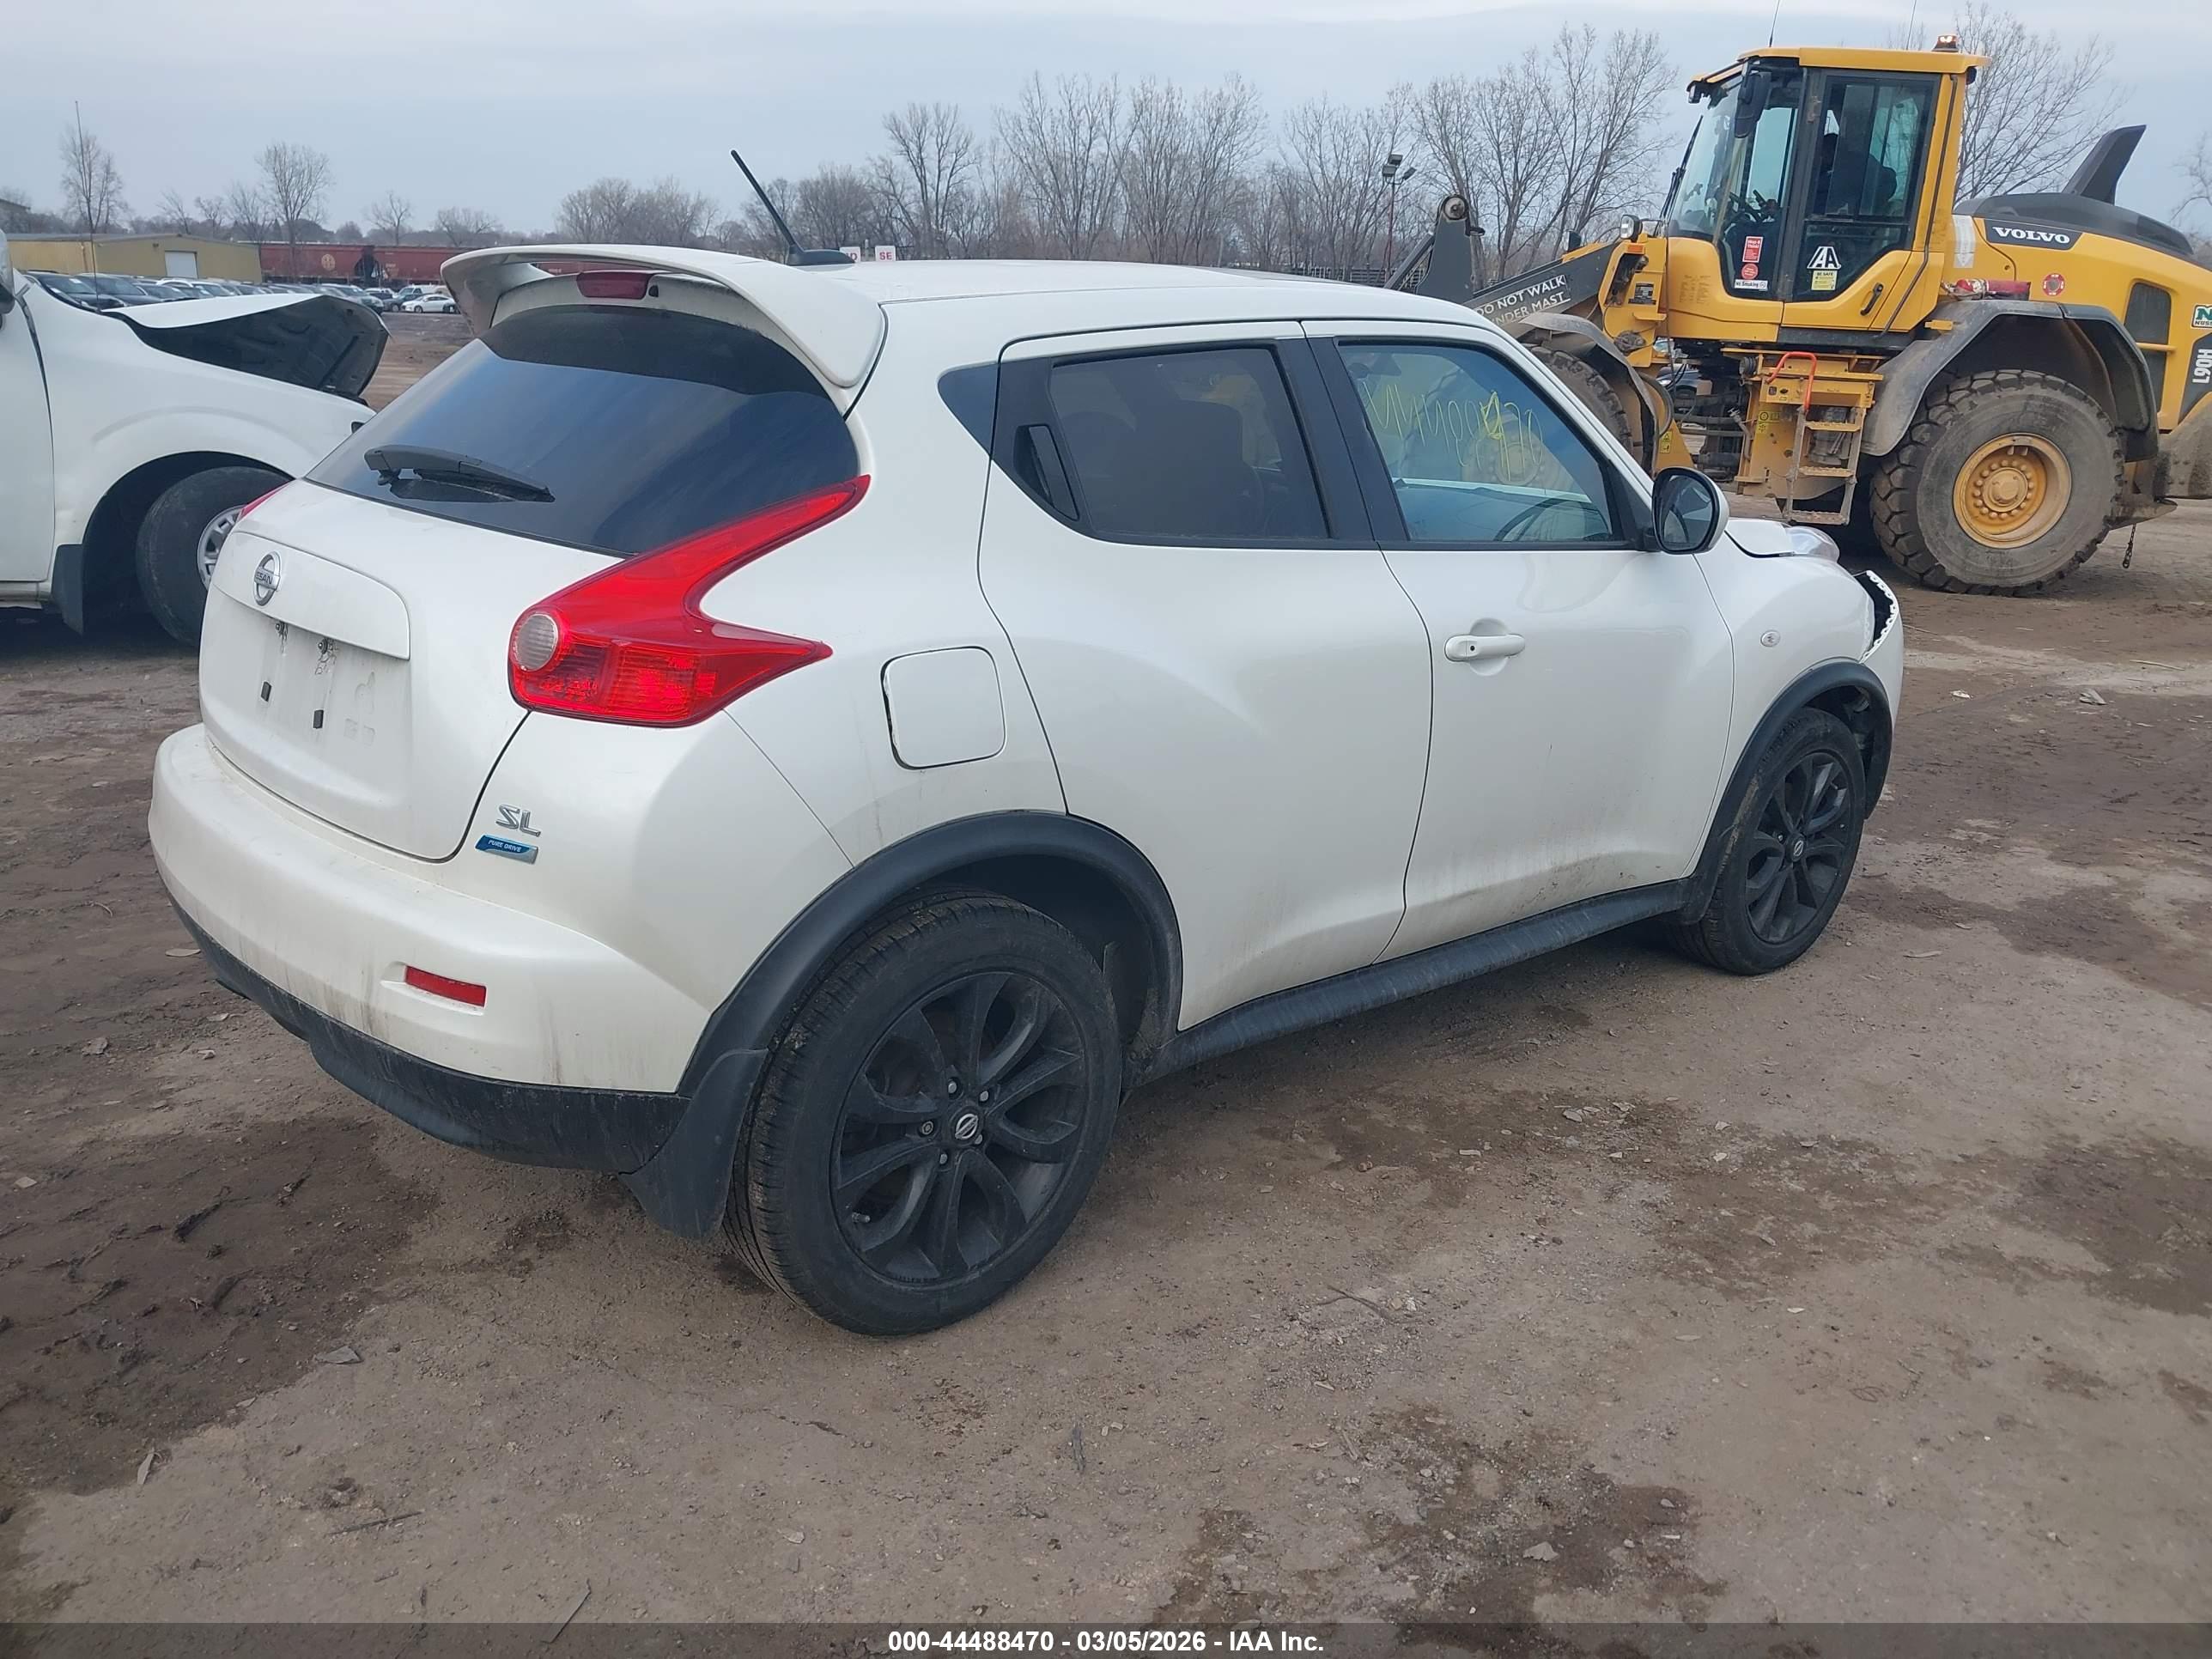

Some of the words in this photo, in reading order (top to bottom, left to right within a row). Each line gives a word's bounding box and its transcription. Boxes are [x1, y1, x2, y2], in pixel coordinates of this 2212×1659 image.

[1992, 227, 2070, 244] VOLVO
[1477, 304, 1494, 317] DO
[1498, 292, 1525, 310] NOT
[1527, 275, 1565, 296] WALK
[1492, 306, 1531, 325] NDER
[1531, 292, 1565, 312] MAST
[2192, 349, 2212, 384] L90H
[495, 804, 541, 837] SL
[488, 839, 505, 848] PURE
[503, 843, 522, 853] DRIVE
